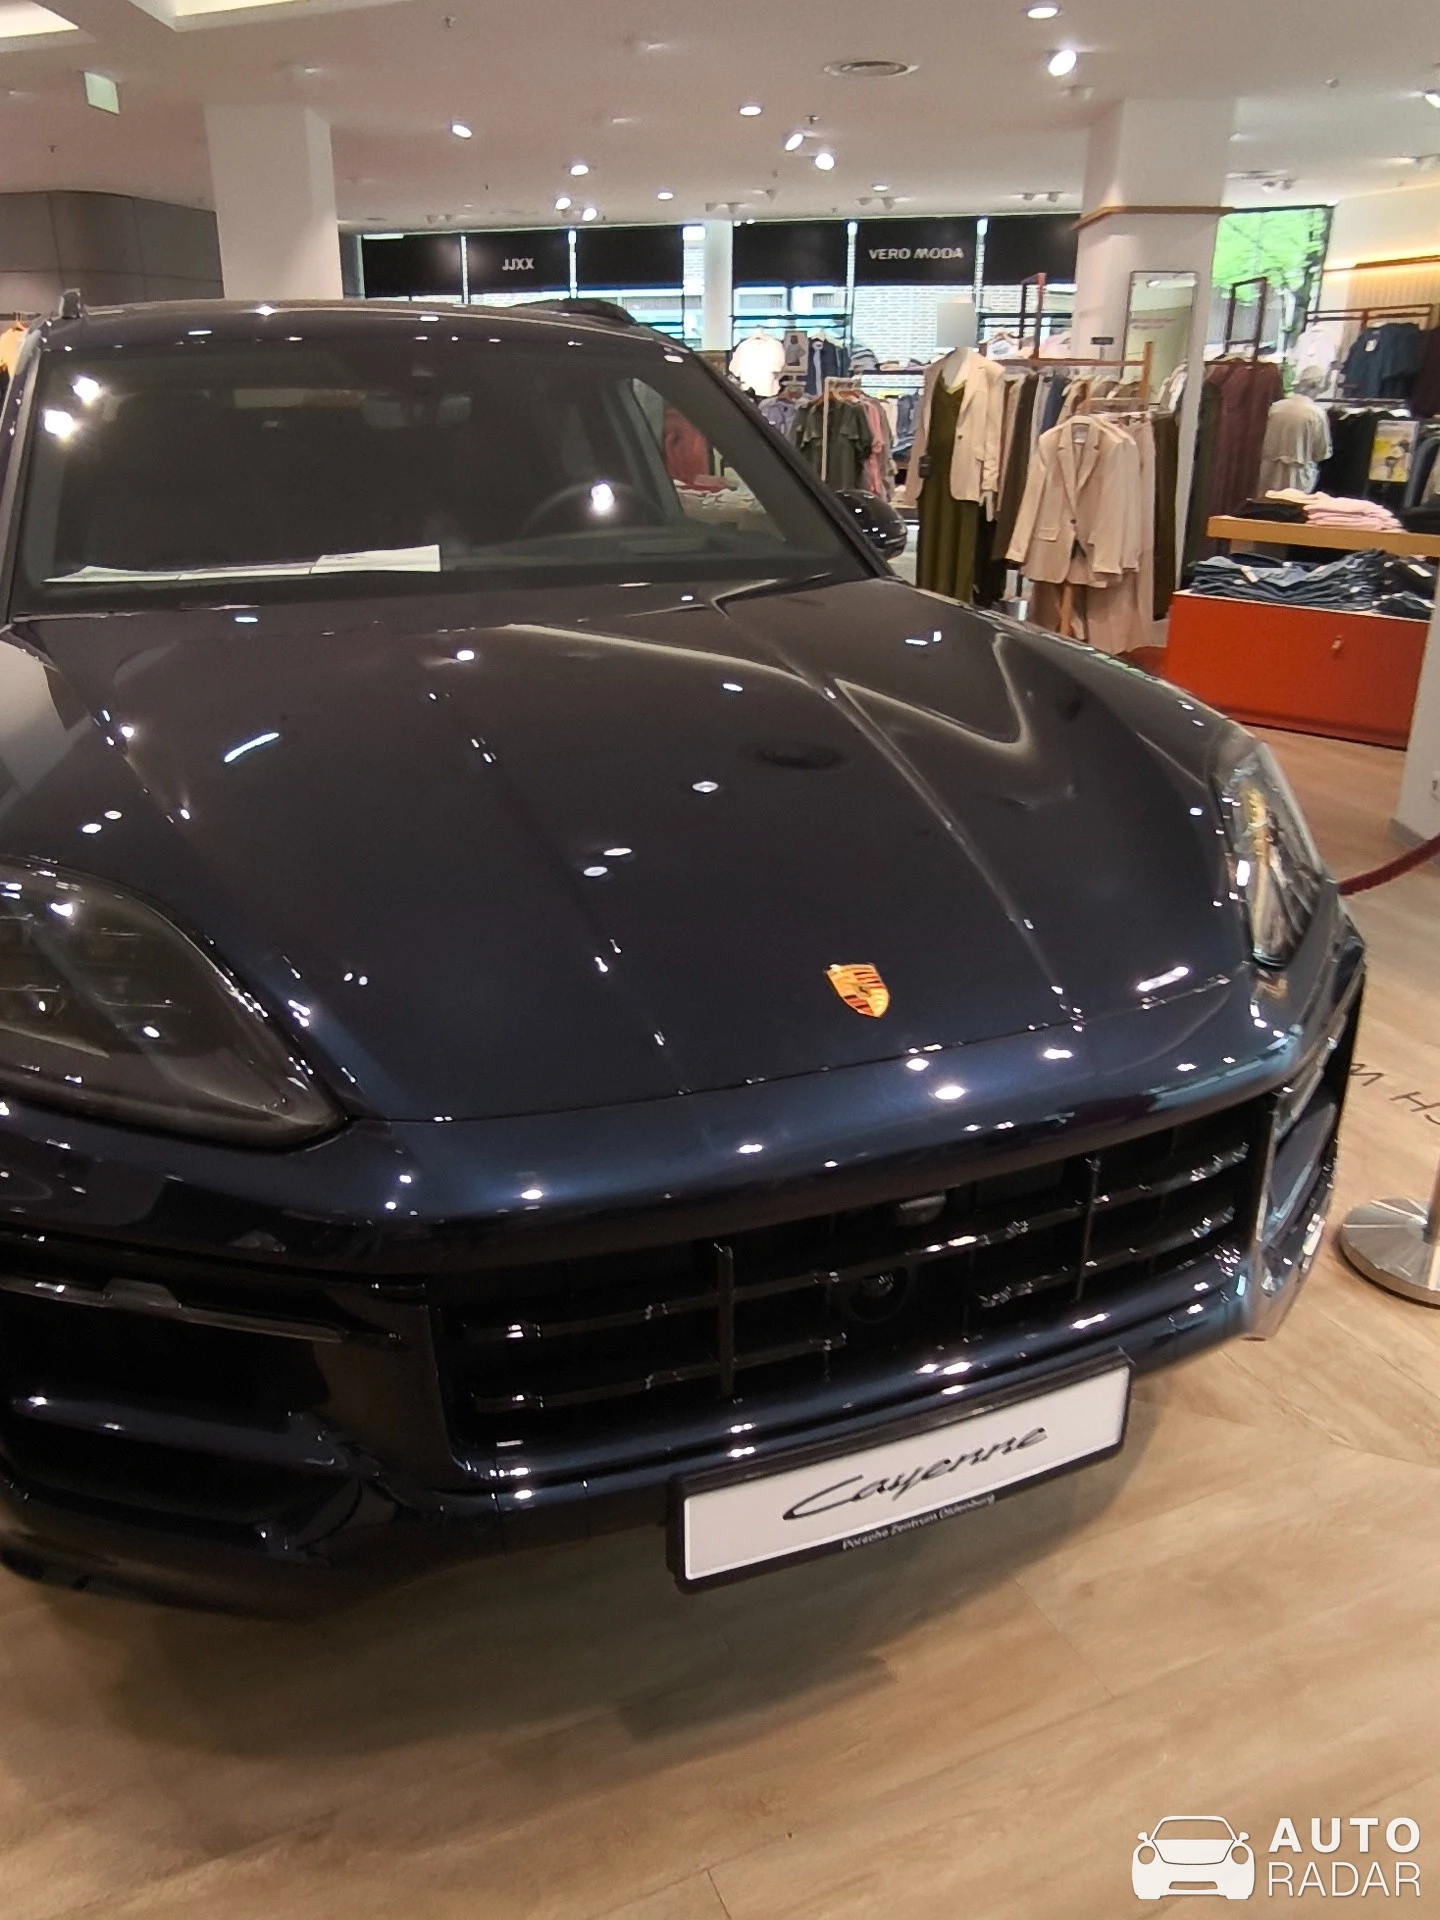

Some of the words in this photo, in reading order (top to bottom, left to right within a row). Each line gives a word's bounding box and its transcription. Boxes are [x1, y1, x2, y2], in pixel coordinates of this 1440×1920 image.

[868, 248, 911, 260] VERO
[913, 247, 964, 260] MODA
[502, 258, 534, 271] JJXX
[783, 1426, 1048, 1521] Cayenne
